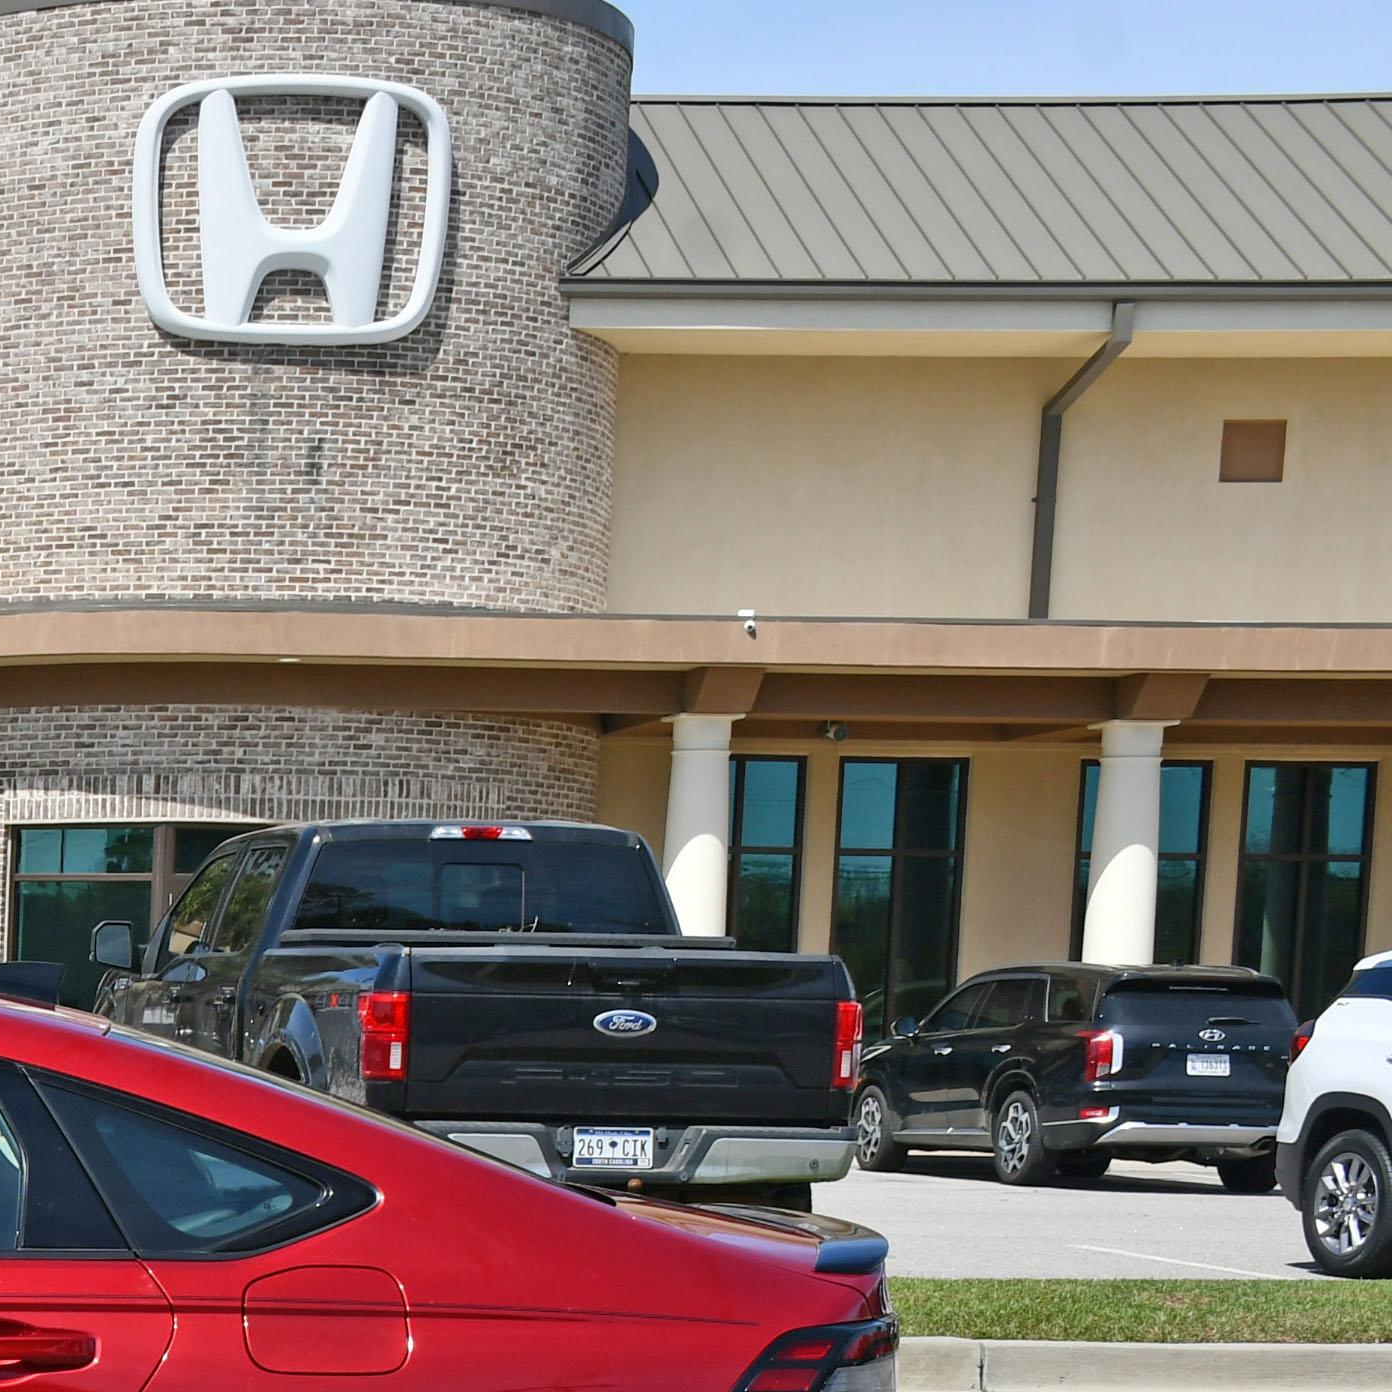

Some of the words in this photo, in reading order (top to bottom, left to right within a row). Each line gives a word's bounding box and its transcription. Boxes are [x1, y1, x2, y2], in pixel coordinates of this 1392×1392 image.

[608, 1015, 642, 1031] Ford
[578, 1138, 604, 1157] 269
[622, 1139, 647, 1158] CIK
